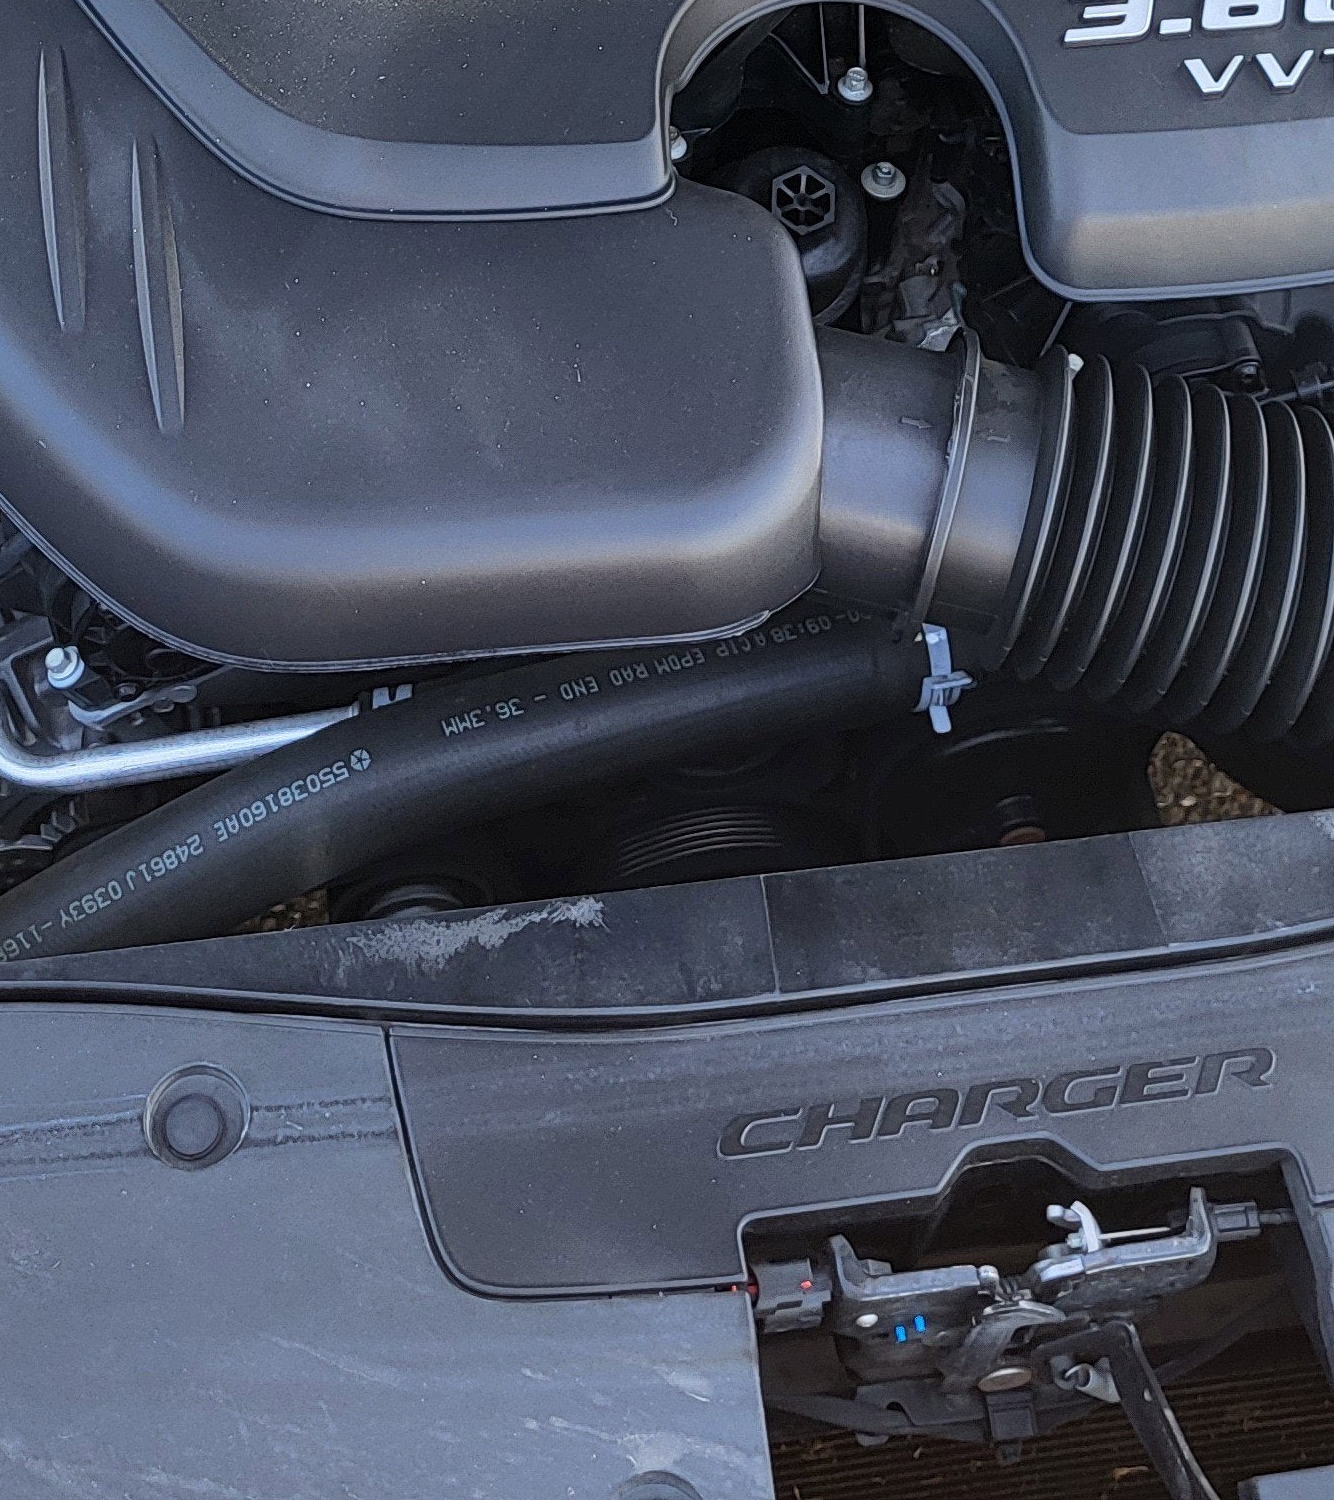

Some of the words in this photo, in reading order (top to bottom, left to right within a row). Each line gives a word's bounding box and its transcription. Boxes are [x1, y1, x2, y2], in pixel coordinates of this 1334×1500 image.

[608, 662, 649, 686] RAD
[653, 647, 706, 675] EPDM
[559, 675, 600, 701] END
[441, 697, 524, 738] 36.3MM
[213, 760, 351, 844] 55038160AE
[716, 1046, 1278, 1161] CHARGER
